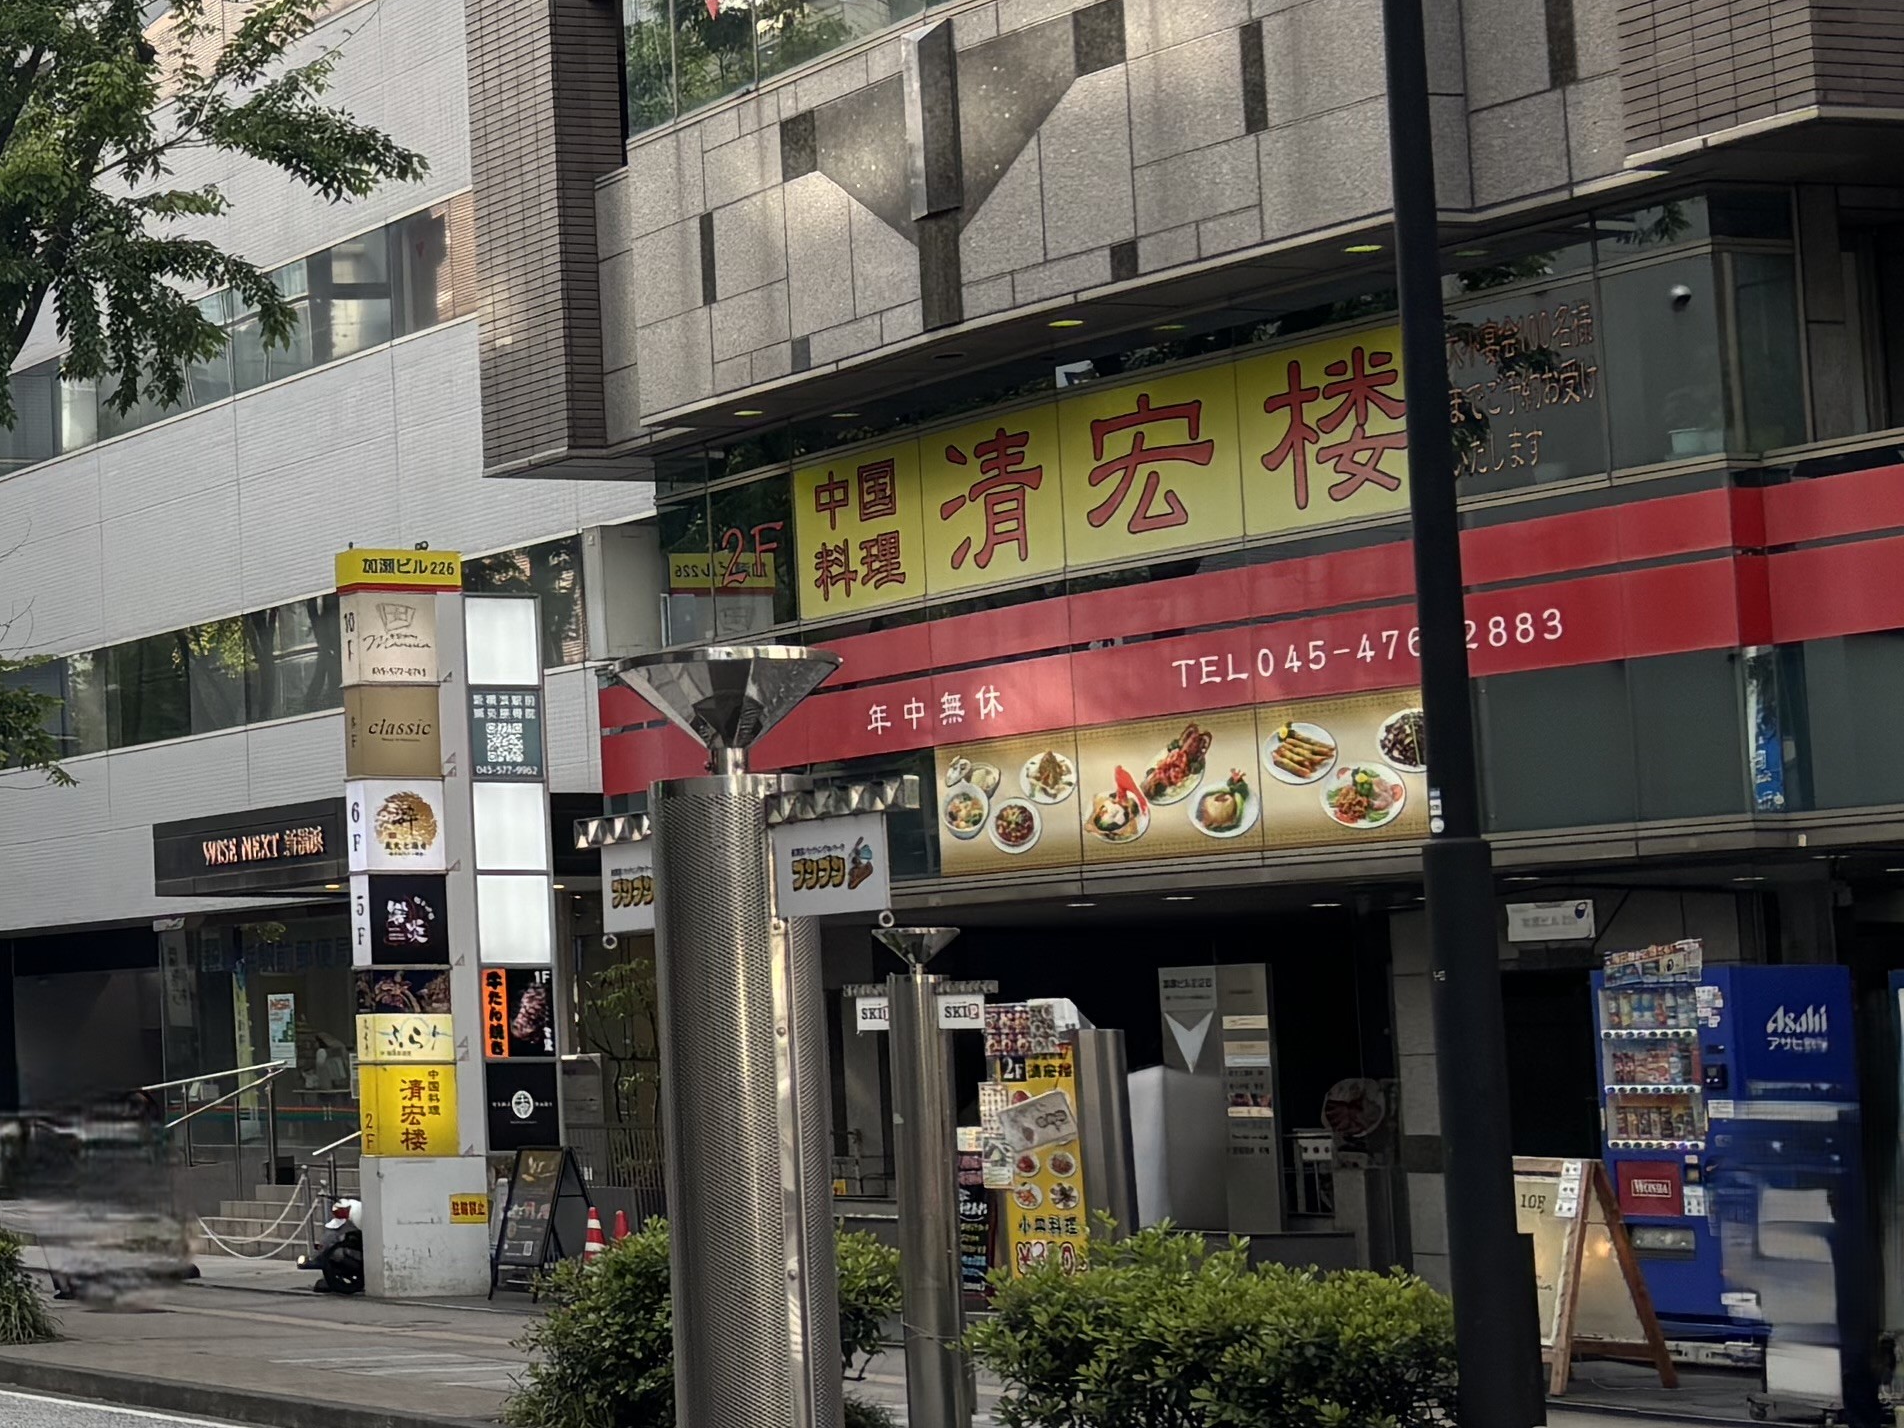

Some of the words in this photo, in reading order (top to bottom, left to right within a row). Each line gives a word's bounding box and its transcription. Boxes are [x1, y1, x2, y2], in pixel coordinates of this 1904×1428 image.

[938, 342, 1410, 571] 清宏楼
[814, 457, 897, 531] 中国
[721, 520, 784, 587] 2F
[814, 529, 907, 602] 料理
[1172, 608, 1565, 692] TEL045-4762883
[368, 718, 433, 736] classic
[865, 686, 1005, 734] 年中無休
[202, 836, 238, 866] WISE
[240, 832, 281, 862] NEXT
[861, 1005, 889, 1021] SKI
[1765, 1003, 1829, 1035] Asahi
[1002, 1056, 1025, 1080] 2F
[399, 1079, 429, 1152] 清宏楼
